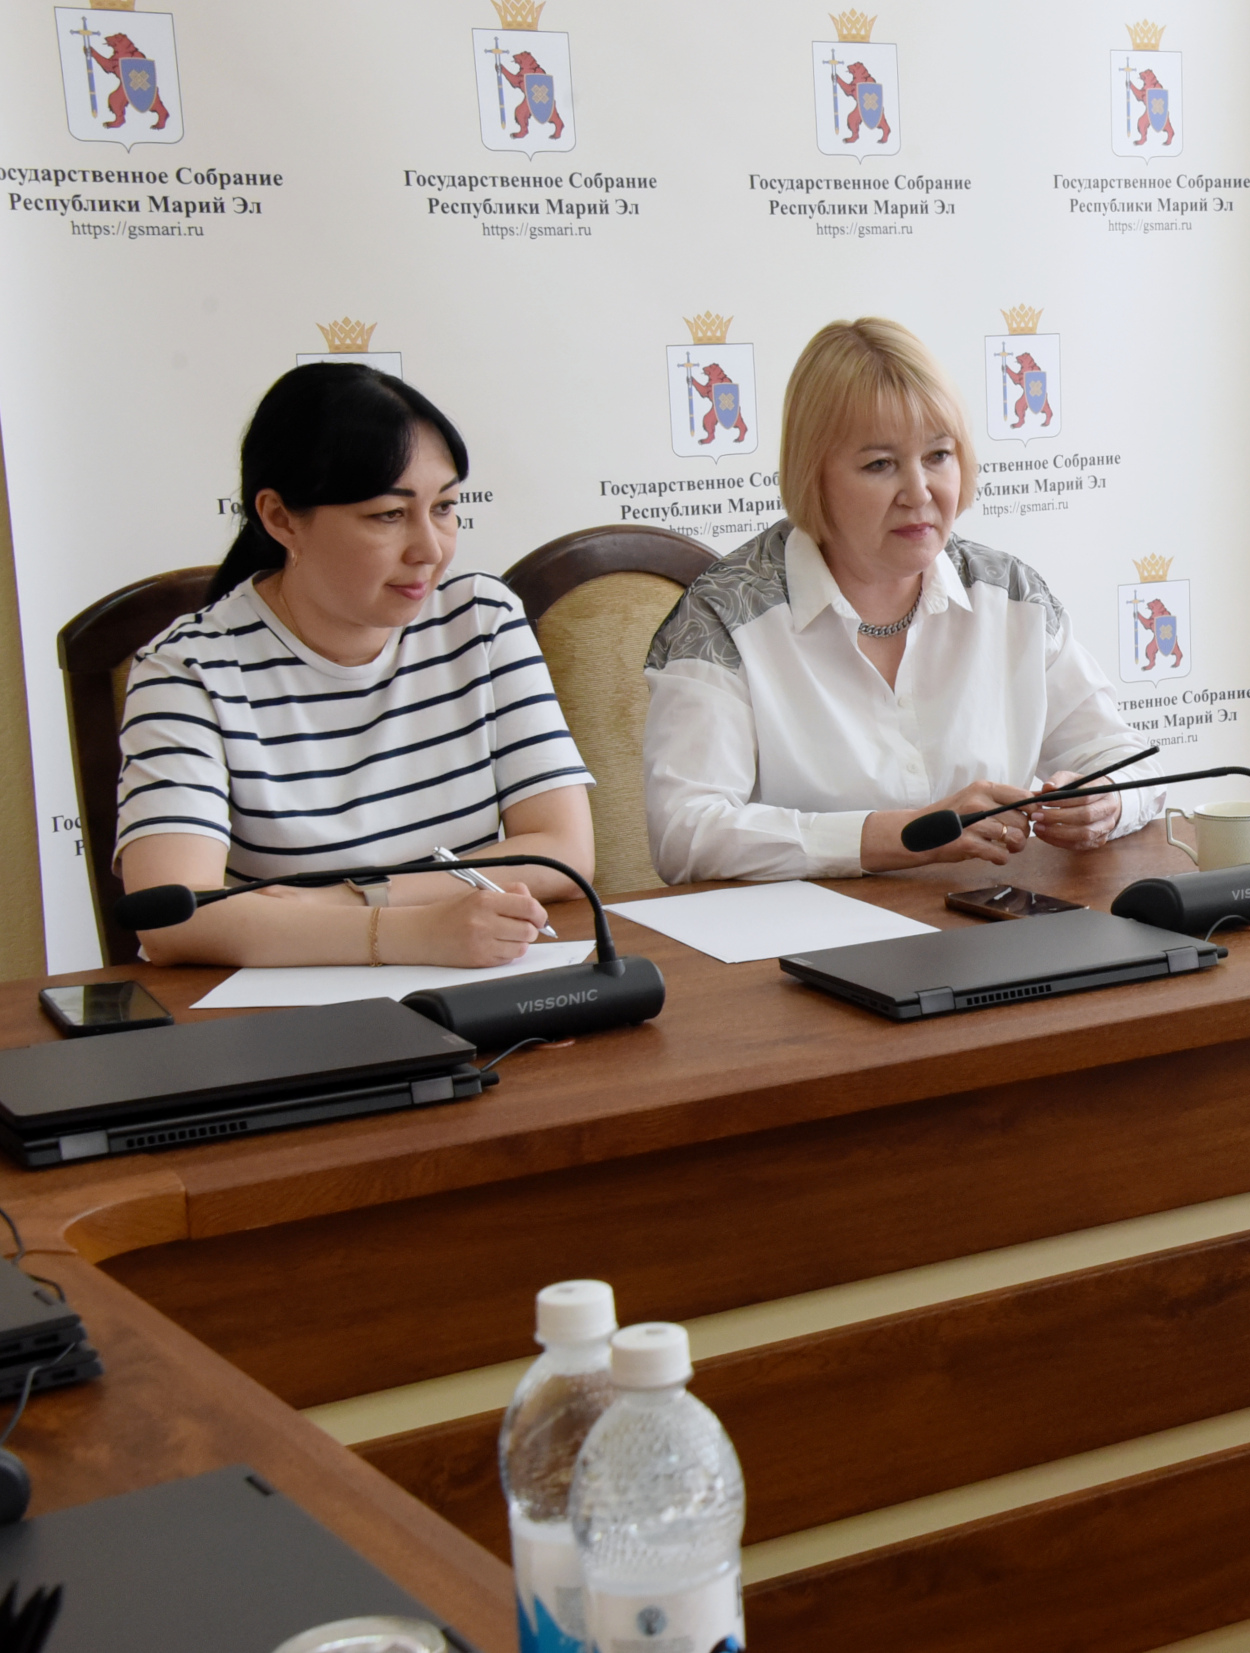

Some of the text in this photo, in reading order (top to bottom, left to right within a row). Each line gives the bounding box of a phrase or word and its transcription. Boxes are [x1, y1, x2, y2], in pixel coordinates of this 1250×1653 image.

[0, 166, 284, 190] осударственное Собрание
[403, 170, 658, 193] Государственное Собрание
[748, 174, 972, 195] Государственное Собрание
[1053, 174, 1172, 193] Государственное
[8, 192, 263, 218] Республики Марий Эл
[427, 197, 640, 219] Республики Марий Эл
[769, 199, 955, 219] Республики Марий Эл
[1069, 197, 1234, 217] Республики Марий Эл
[70, 220, 204, 240] https://gsmari.ru
[482, 222, 592, 240] https://gsmari.ru
[816, 222, 913, 239] https://gsmari.ru
[1108, 218, 1193, 235] https://gsmari.ru
[976, 453, 1122, 474] ственное Собрание
[599, 476, 745, 499] Государственное
[976, 474, 1107, 501] ублики Марий Эл
[620, 502, 723, 522] Республики
[982, 498, 1069, 518] https://gsmari.ru
[669, 519, 769, 538] https://gsmari.ru
[1163, 711, 1213, 729] Марий
[1217, 708, 1238, 723] Эл
[517, 988, 599, 1015] VISSONIC
